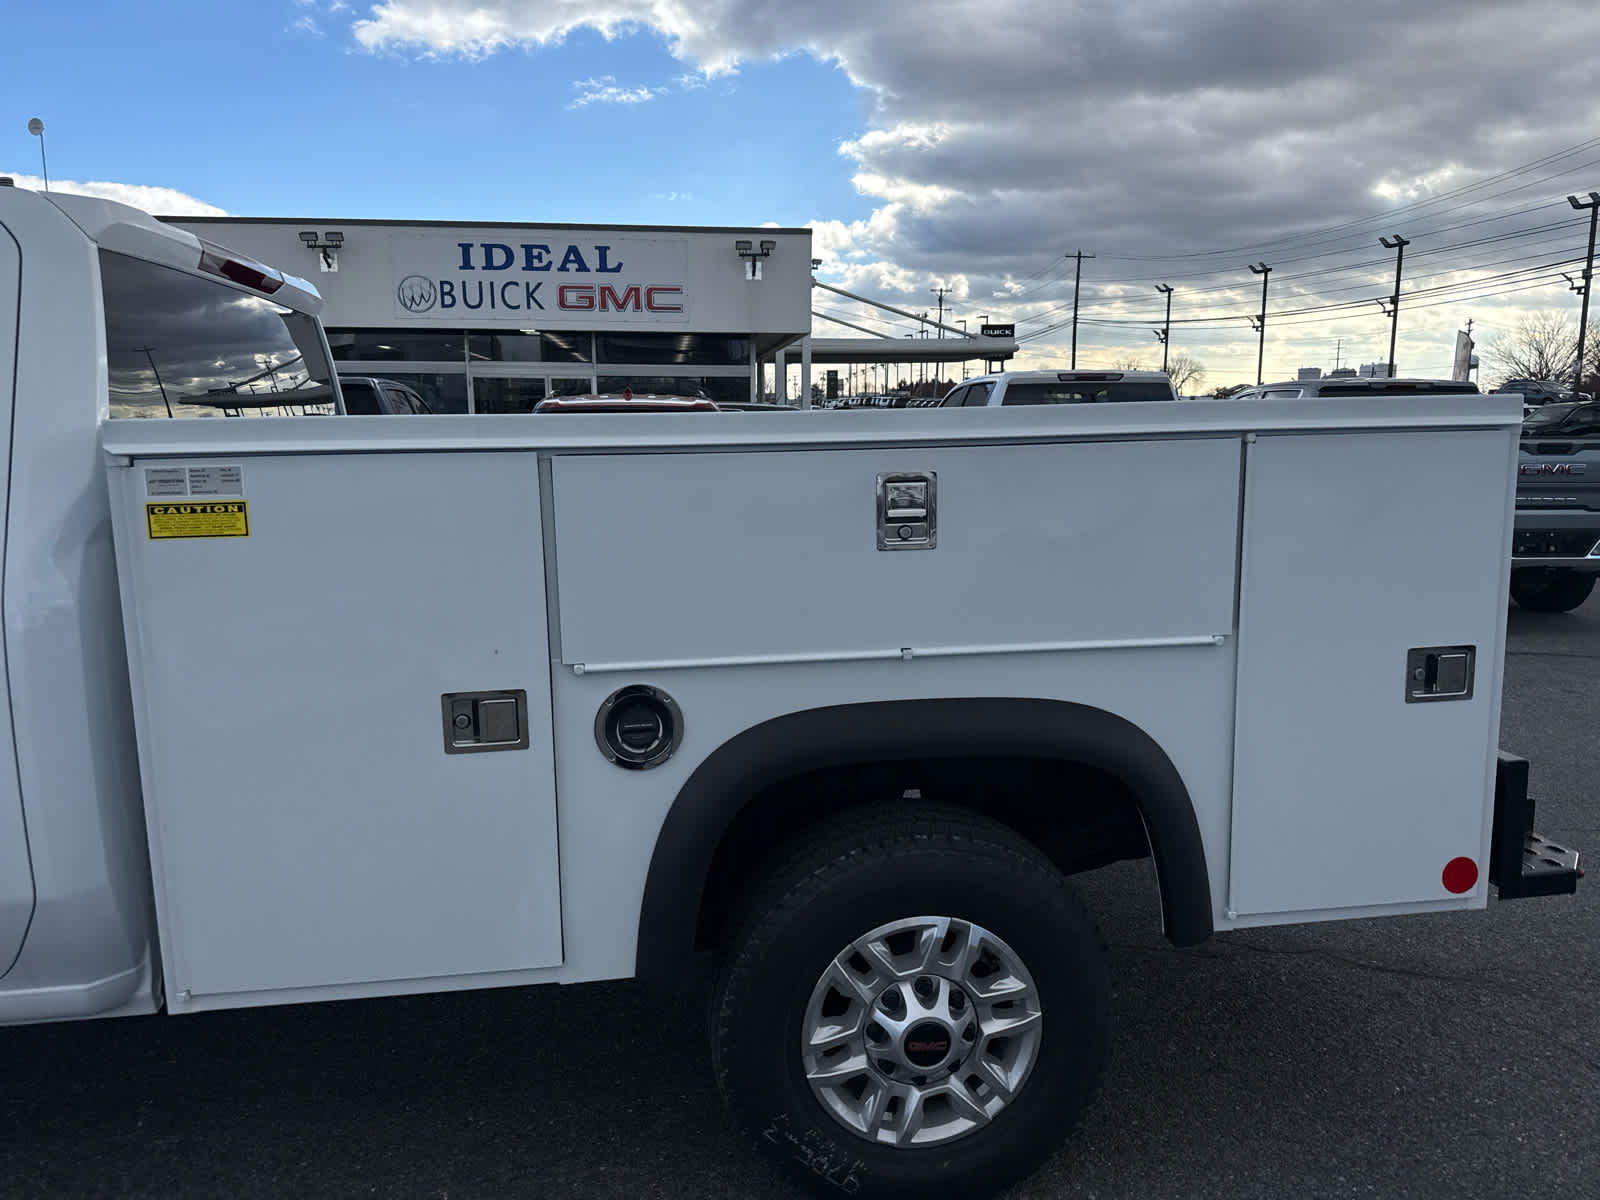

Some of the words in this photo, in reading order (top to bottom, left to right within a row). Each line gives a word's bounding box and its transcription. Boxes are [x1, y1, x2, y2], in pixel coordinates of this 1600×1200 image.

[457, 242, 624, 273] IDEAL
[439, 280, 545, 310] BUICK
[557, 283, 684, 313] GMC
[1520, 463, 1586, 474] GMC
[153, 505, 240, 514] CAUTION
